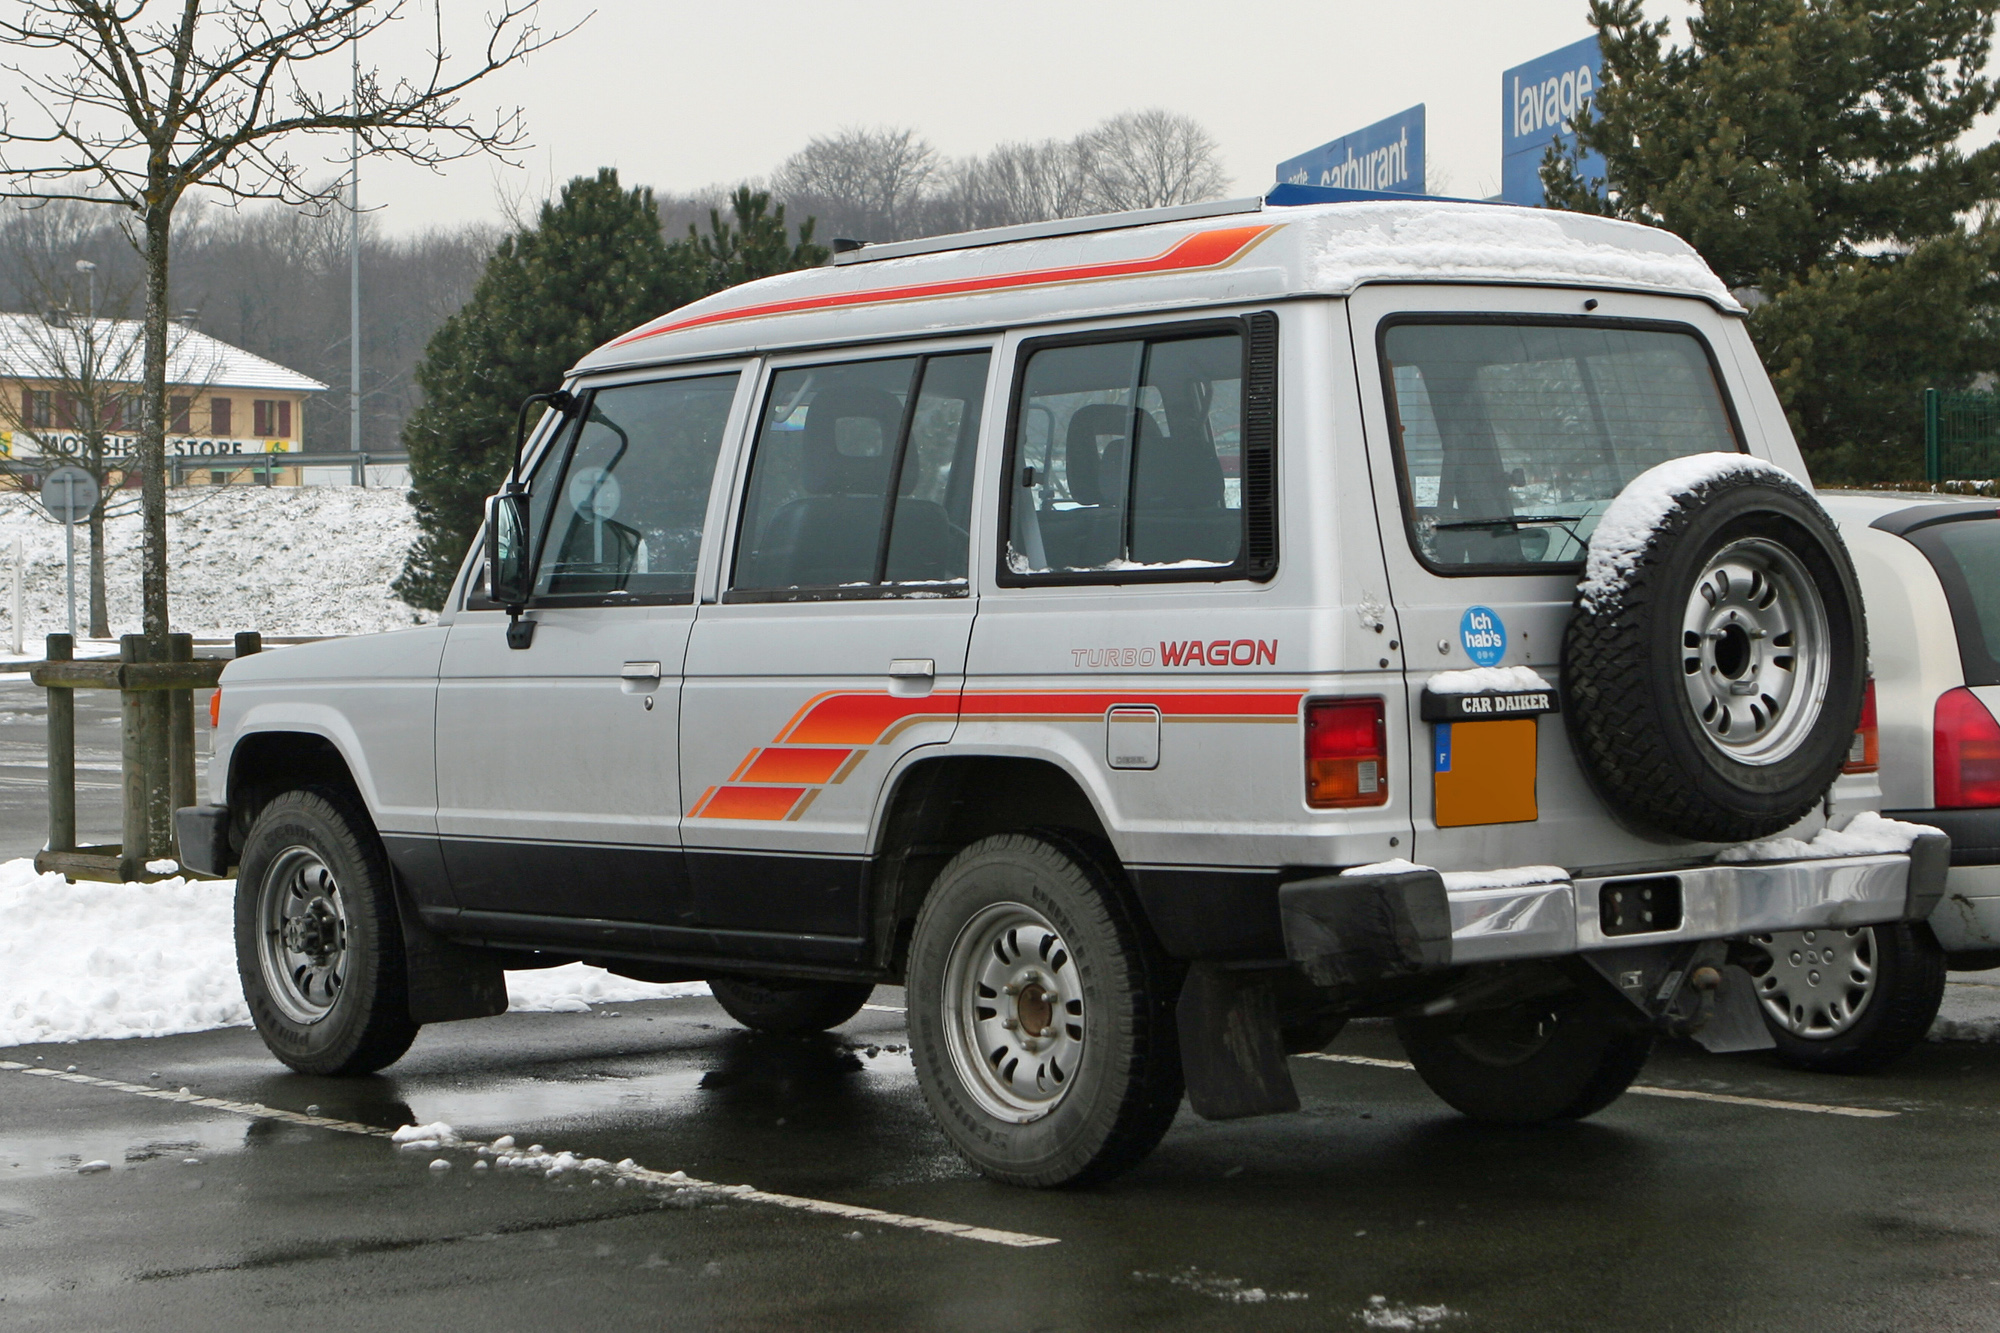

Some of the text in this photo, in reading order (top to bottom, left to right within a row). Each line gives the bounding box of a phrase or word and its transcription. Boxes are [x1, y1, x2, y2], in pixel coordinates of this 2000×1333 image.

[1514, 64, 1594, 138] lavage
[1470, 612, 1492, 630] Ich
[1464, 630, 1502, 648] hab's
[1071, 639, 1278, 668] TURBO WAGON
[1461, 694, 1550, 714] CAR DAIKER
[1439, 753, 1447, 765] F
